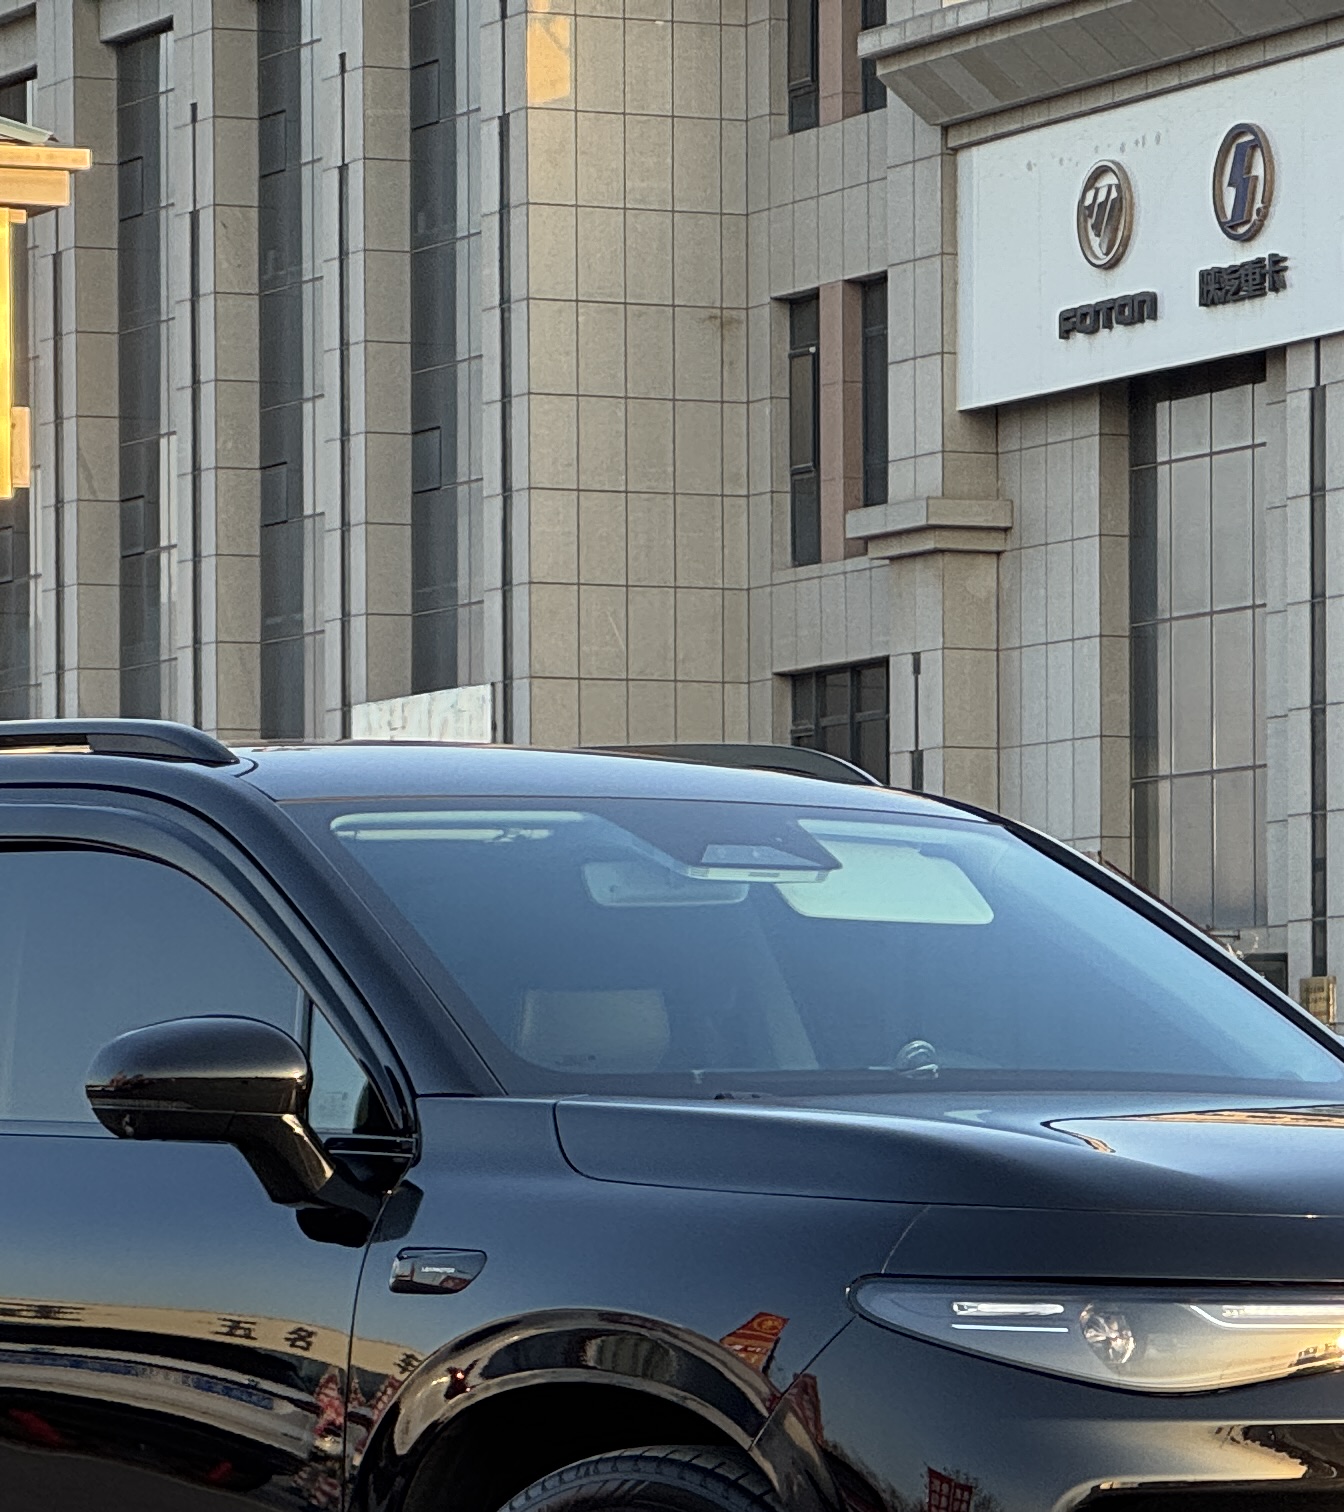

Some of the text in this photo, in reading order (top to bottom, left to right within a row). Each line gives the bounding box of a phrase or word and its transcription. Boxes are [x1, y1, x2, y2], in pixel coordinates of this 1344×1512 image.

[1198, 253, 1289, 307] 陕汽重卡
[1058, 291, 1158, 340] FOTON
